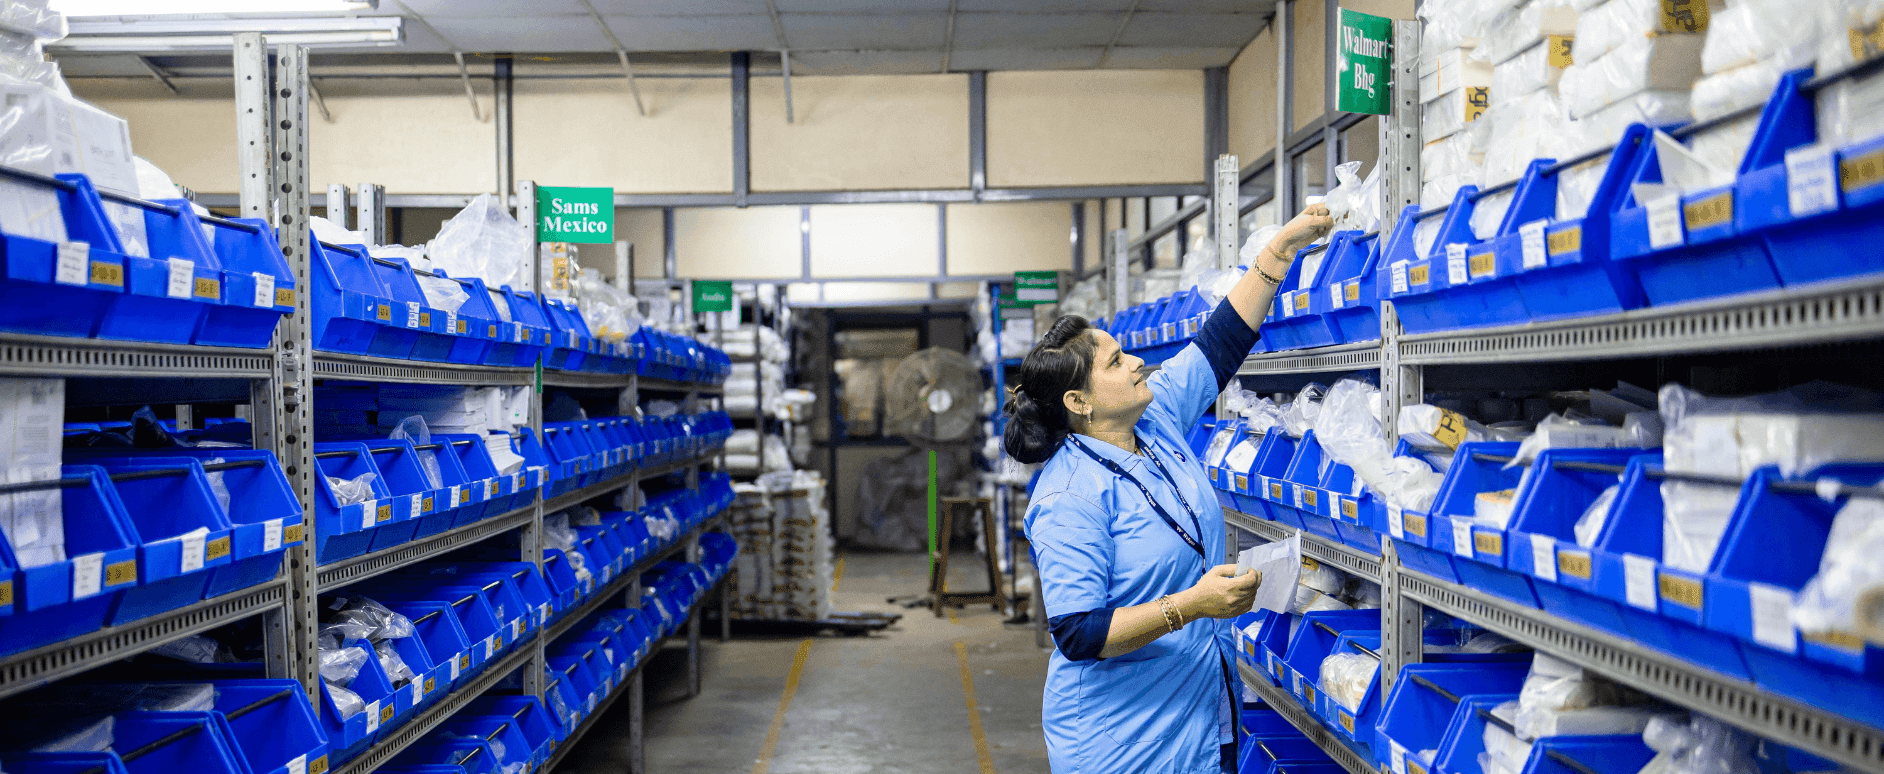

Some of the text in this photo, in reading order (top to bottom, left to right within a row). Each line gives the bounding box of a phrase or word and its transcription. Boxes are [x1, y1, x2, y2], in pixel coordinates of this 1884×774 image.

[1343, 26, 1388, 59] Walmart
[1354, 62, 1375, 98] Bhg
[551, 198, 598, 214] Sams
[544, 216, 607, 233] Mexico
